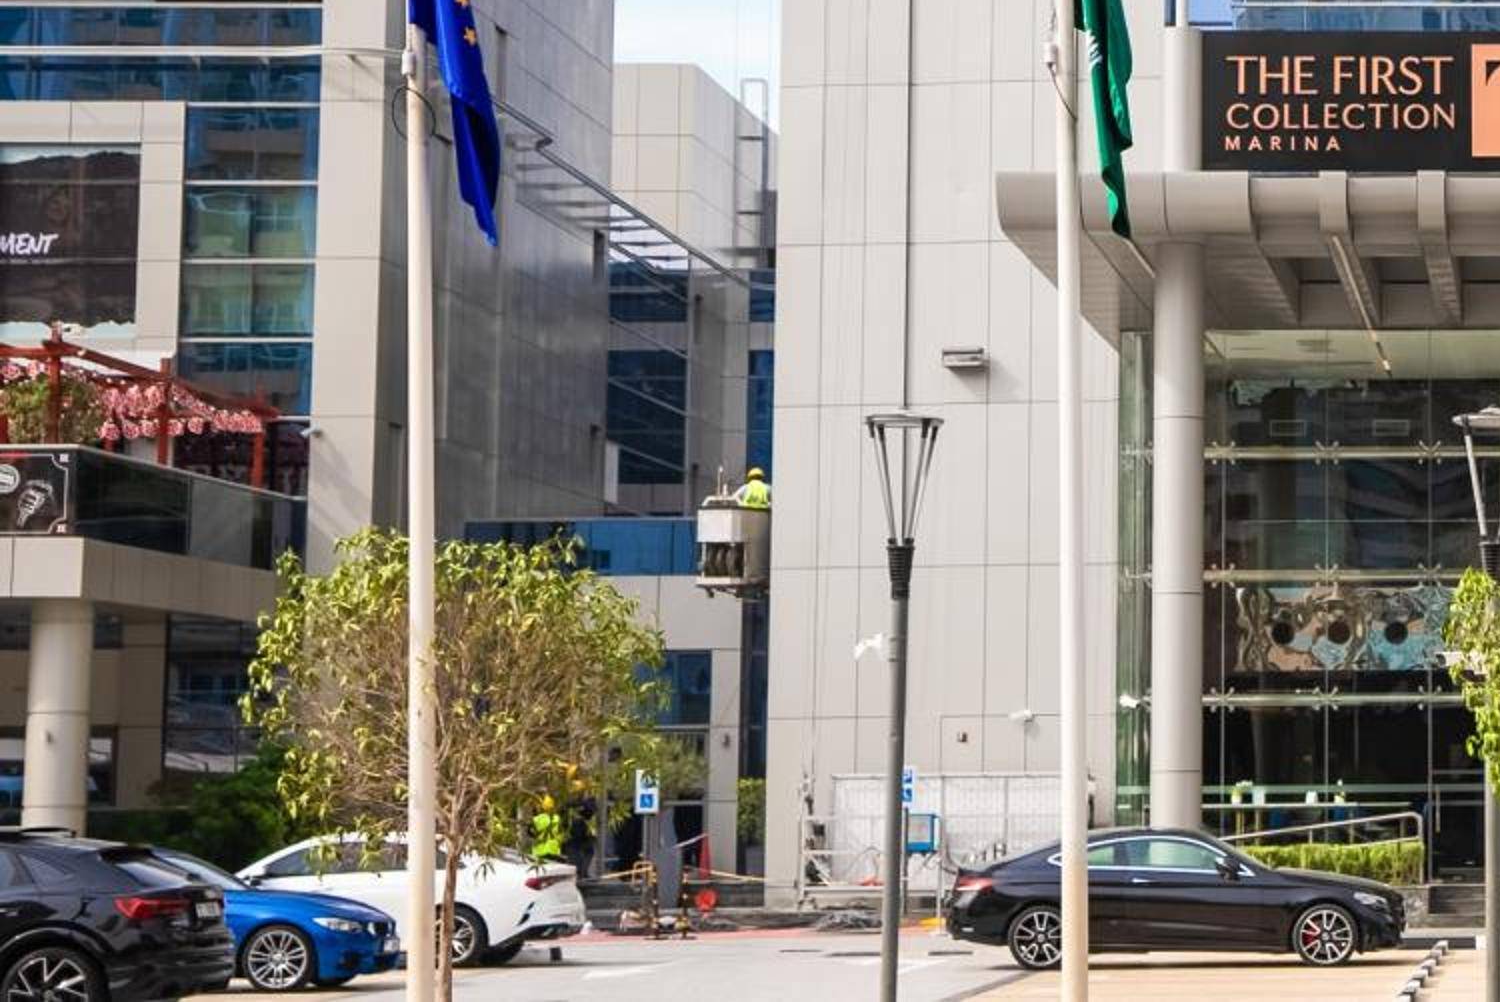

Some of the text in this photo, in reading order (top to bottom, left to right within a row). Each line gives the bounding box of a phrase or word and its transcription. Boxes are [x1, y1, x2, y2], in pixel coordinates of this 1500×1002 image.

[1225, 55, 1454, 96] THE FIRST
[1226, 102, 1455, 130] COLLECTION
[1224, 135, 1340, 151] MARINA
